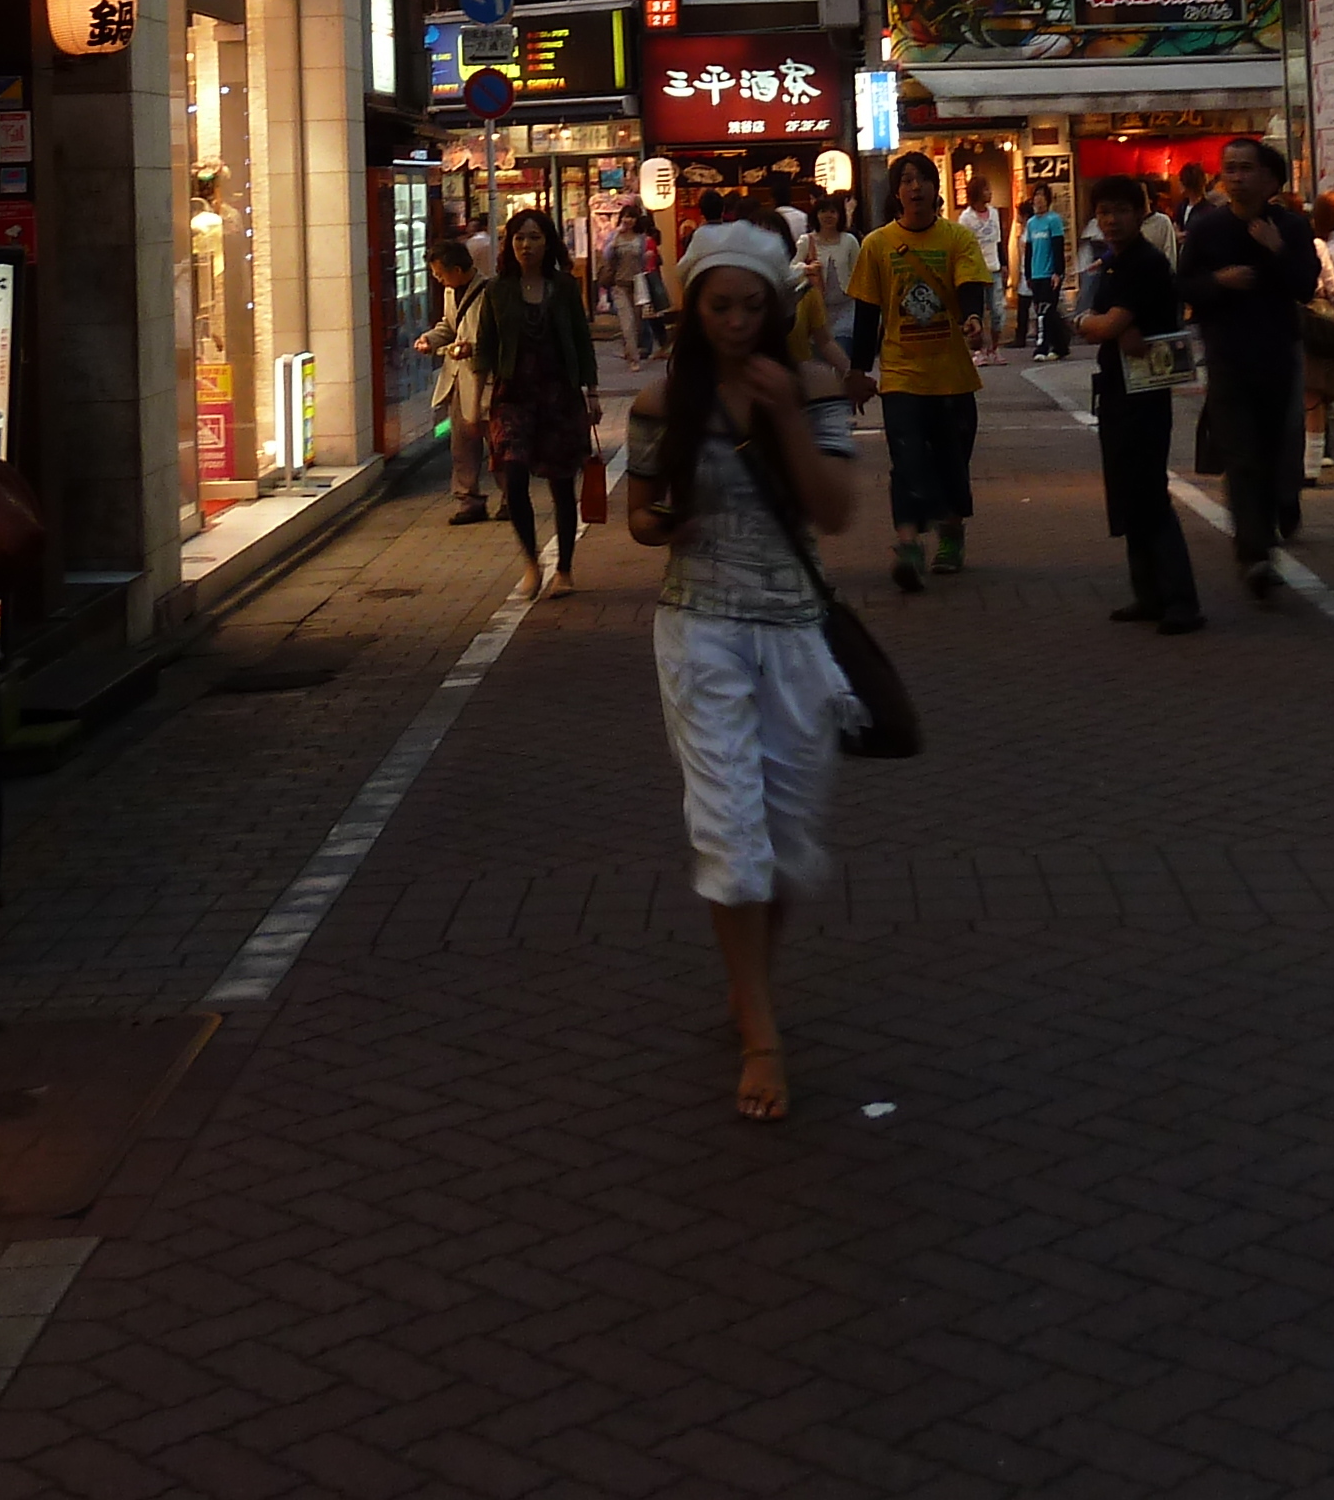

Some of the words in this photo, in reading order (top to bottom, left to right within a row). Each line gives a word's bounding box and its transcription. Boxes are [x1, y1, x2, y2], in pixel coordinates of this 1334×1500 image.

[651, 0, 671, 12] 3F
[652, 14, 672, 26] 2F
[1040, 158, 1070, 178] 2F
